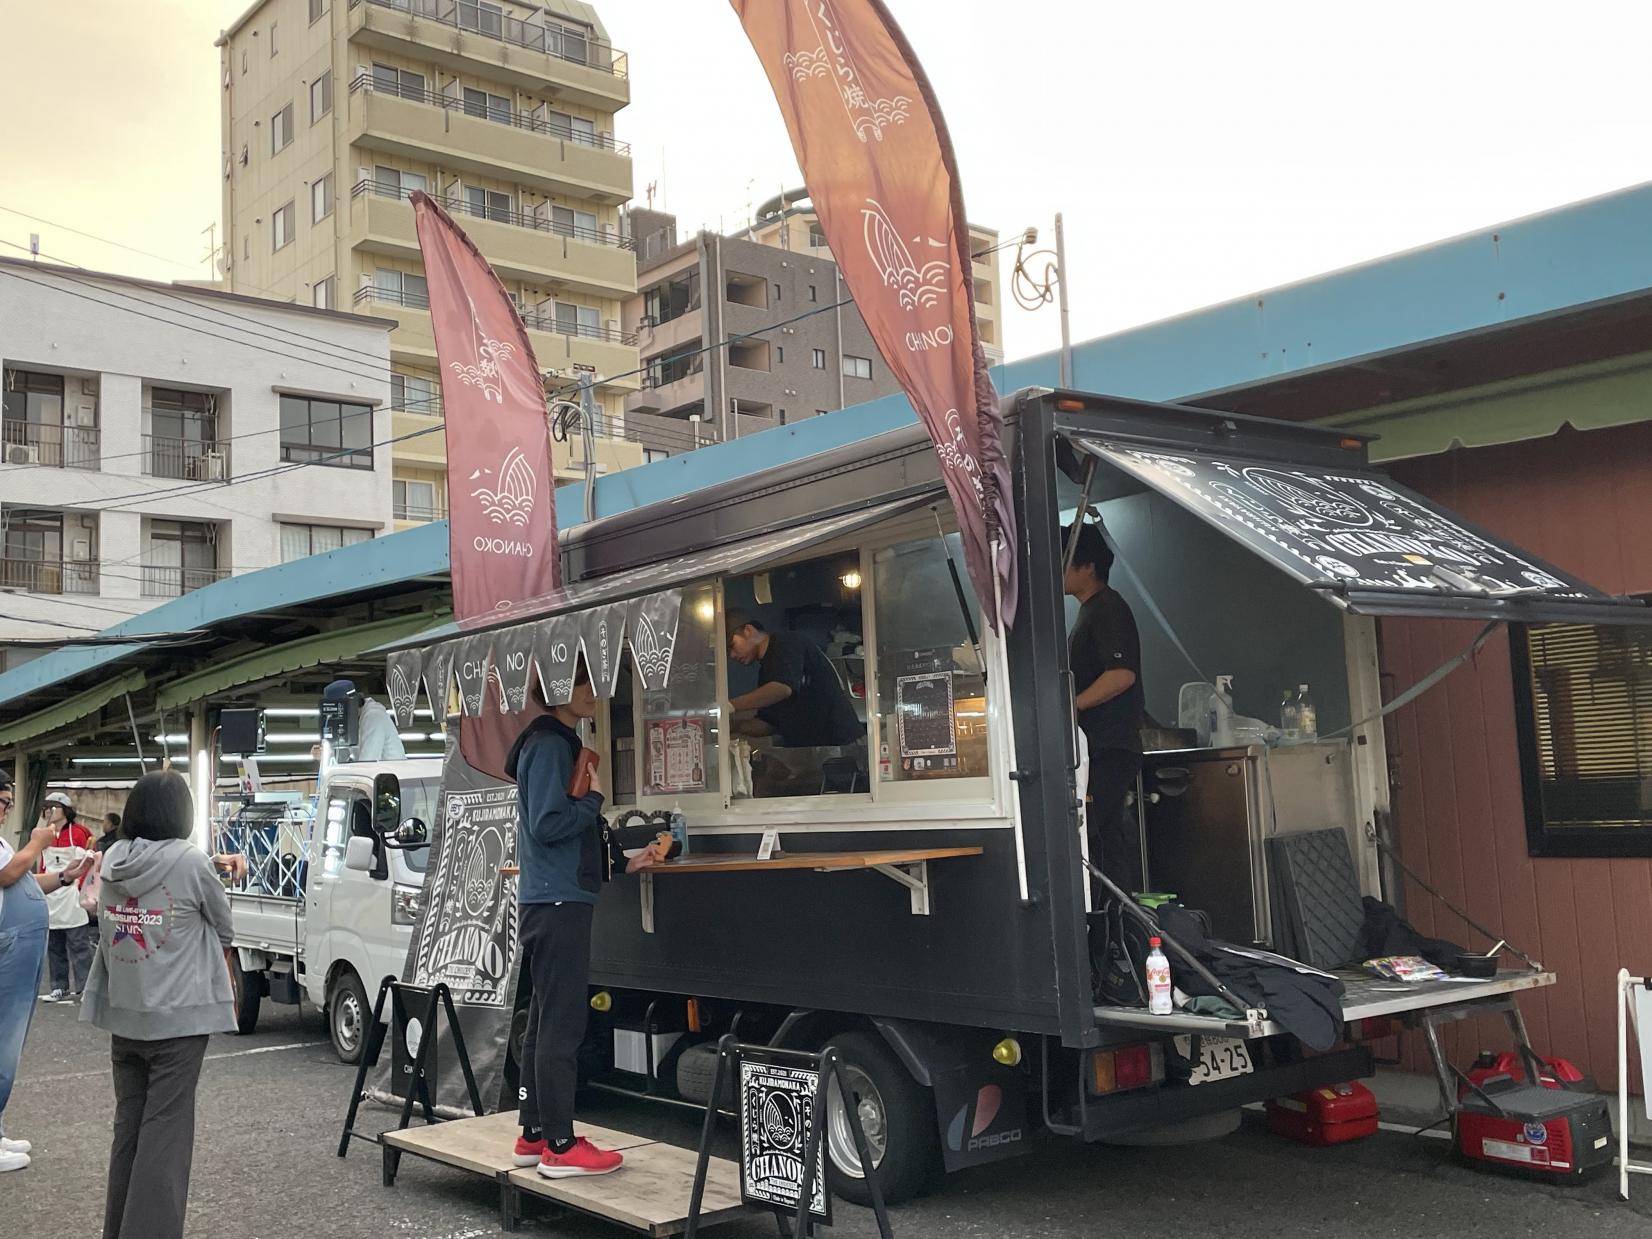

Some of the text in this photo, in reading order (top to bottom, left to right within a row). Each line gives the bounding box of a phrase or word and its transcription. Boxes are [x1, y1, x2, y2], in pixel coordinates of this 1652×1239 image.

[818, 1, 869, 109] くじら焼
[1325, 532, 1482, 566] CHANOKO
[506, 651, 525, 671] NO
[551, 643, 568, 664] KO
[518, 1086, 528, 1101] S
[967, 1128, 1022, 1152] PABCO
[751, 1154, 806, 1187] CHANOK
